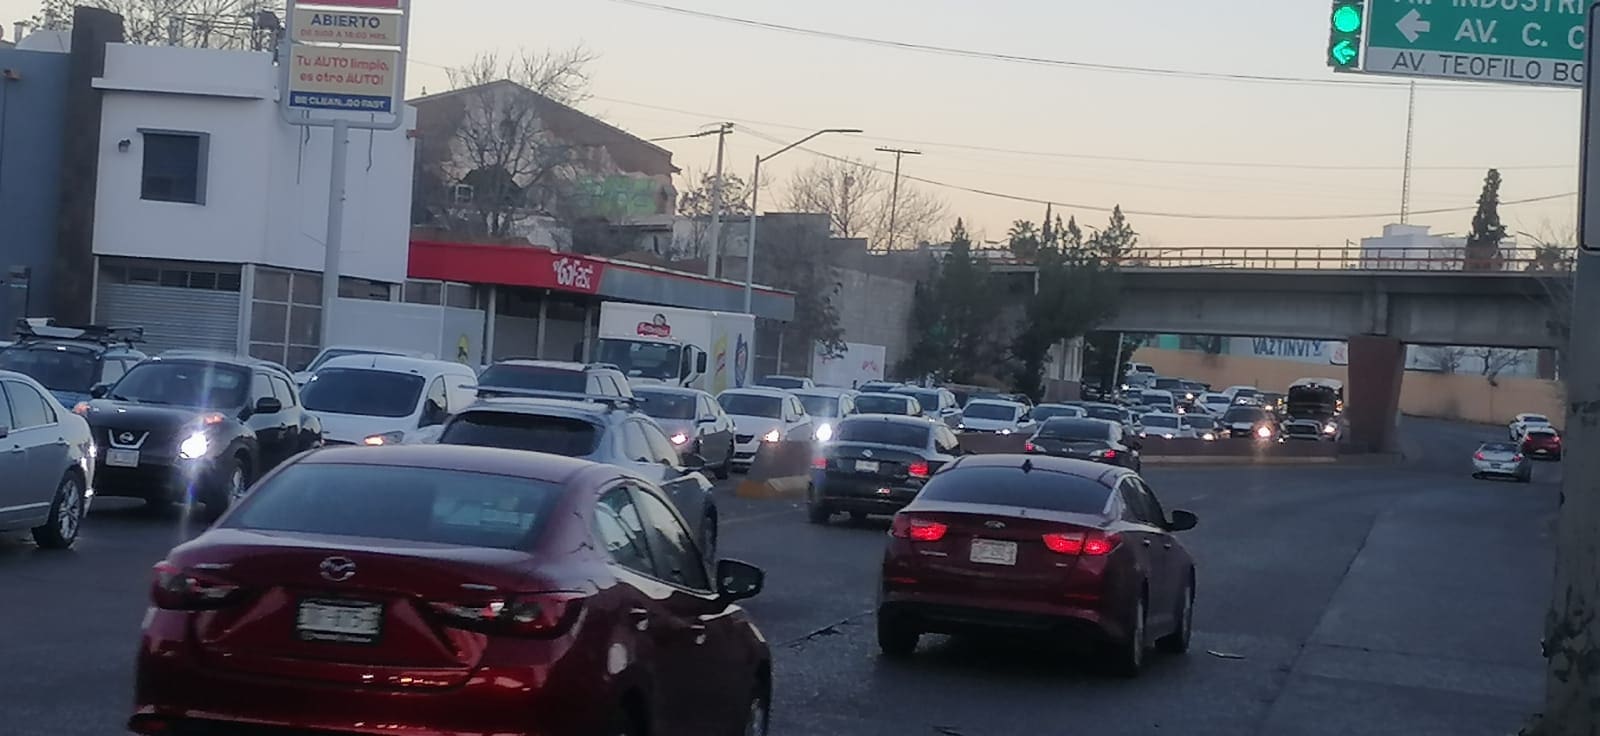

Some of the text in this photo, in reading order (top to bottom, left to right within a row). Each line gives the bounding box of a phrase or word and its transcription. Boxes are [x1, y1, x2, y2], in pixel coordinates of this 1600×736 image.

[311, 14, 380, 29] ABIERTO
[1454, 18, 1497, 44] AV.
[1521, 23, 1548, 47] C.
[296, 55, 311, 66] Tu
[314, 57, 348, 69] AUTO
[1391, 52, 1425, 72] AV
[1438, 54, 1542, 80] TEOFILO
[300, 73, 313, 82] es
[315, 72, 343, 83] otro
